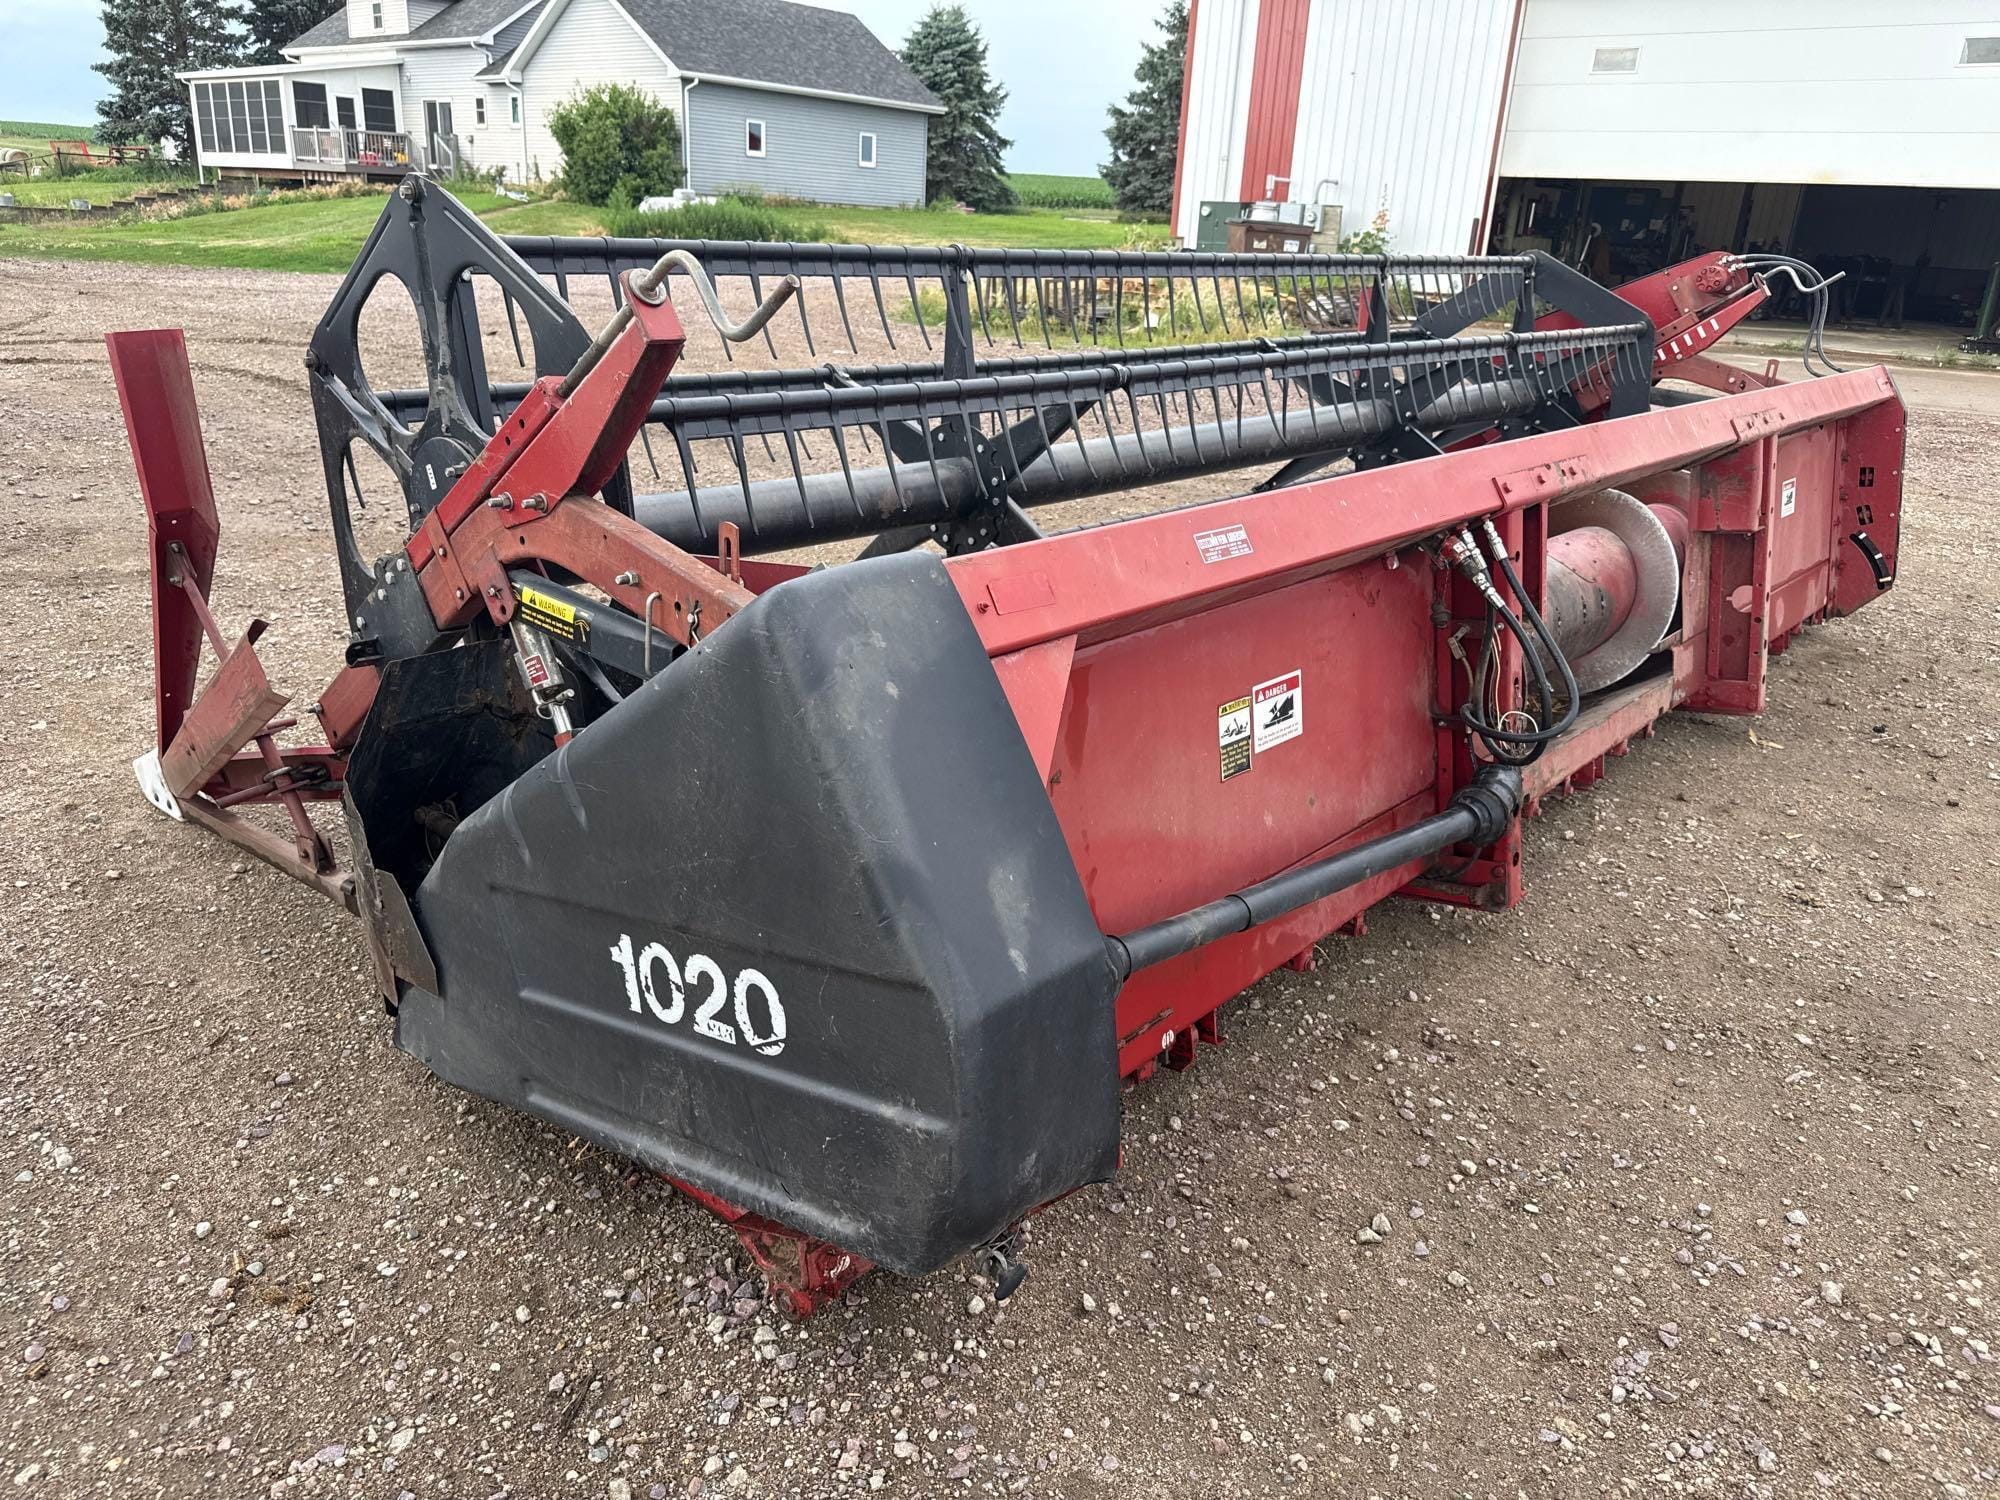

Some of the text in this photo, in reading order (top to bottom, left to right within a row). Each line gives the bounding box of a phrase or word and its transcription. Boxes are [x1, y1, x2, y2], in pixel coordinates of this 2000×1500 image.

[538, 599, 567, 618] WARNING
[1265, 683, 1287, 698] DANGER
[609, 933, 787, 1057] 1020
